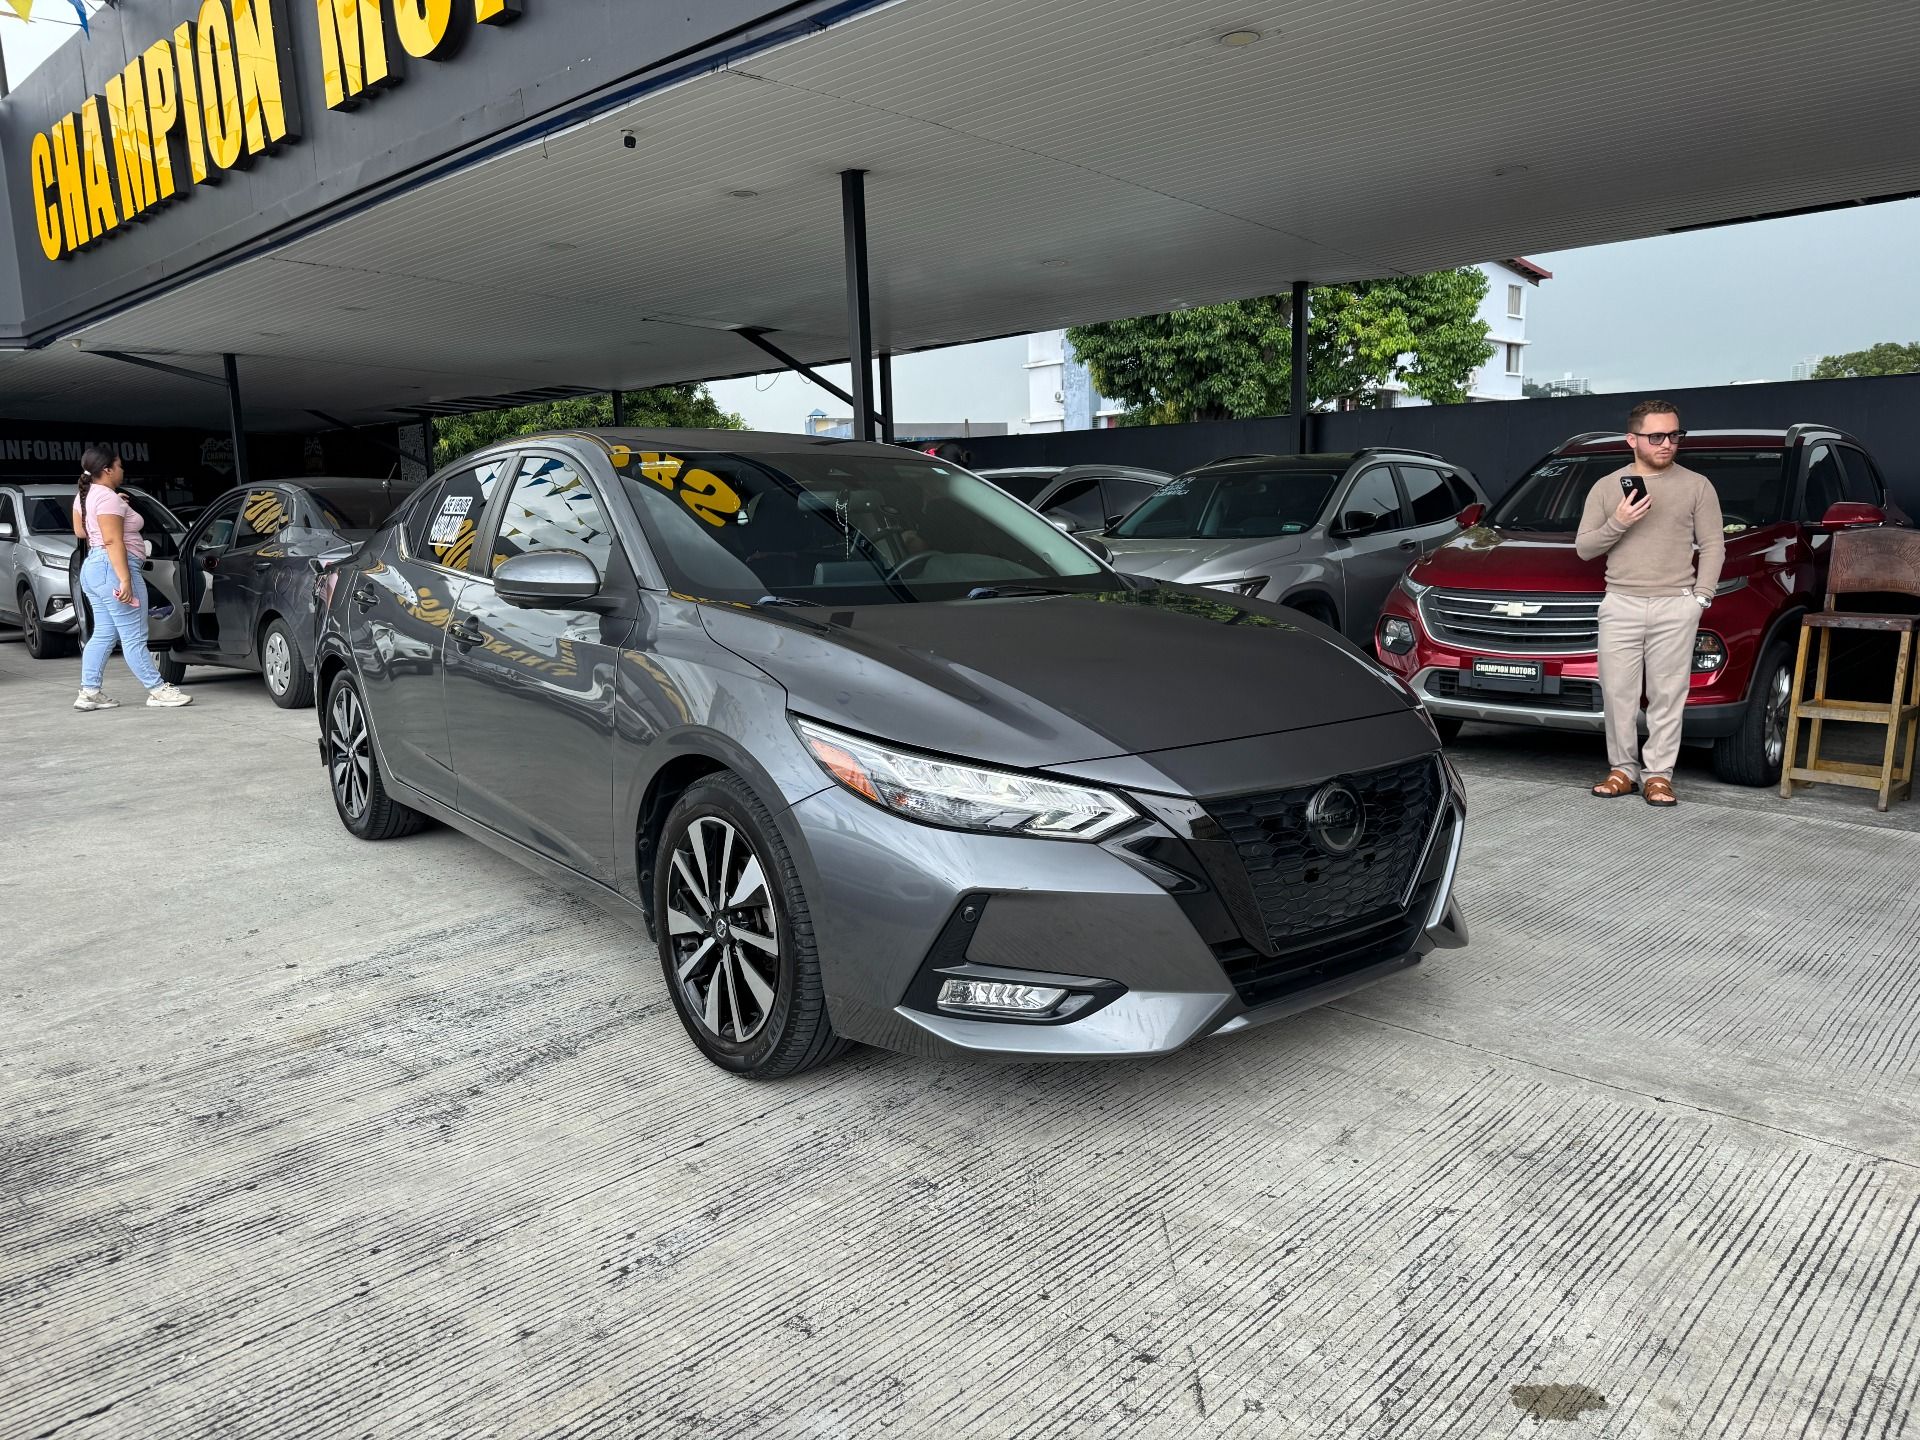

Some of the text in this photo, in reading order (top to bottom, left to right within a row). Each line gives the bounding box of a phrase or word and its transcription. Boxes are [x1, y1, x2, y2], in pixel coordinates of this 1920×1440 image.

[32, 0, 286, 261] CHAMPION
[1476, 664, 1509, 674] CHAMPION
[1510, 666, 1537, 676] MOTORS
